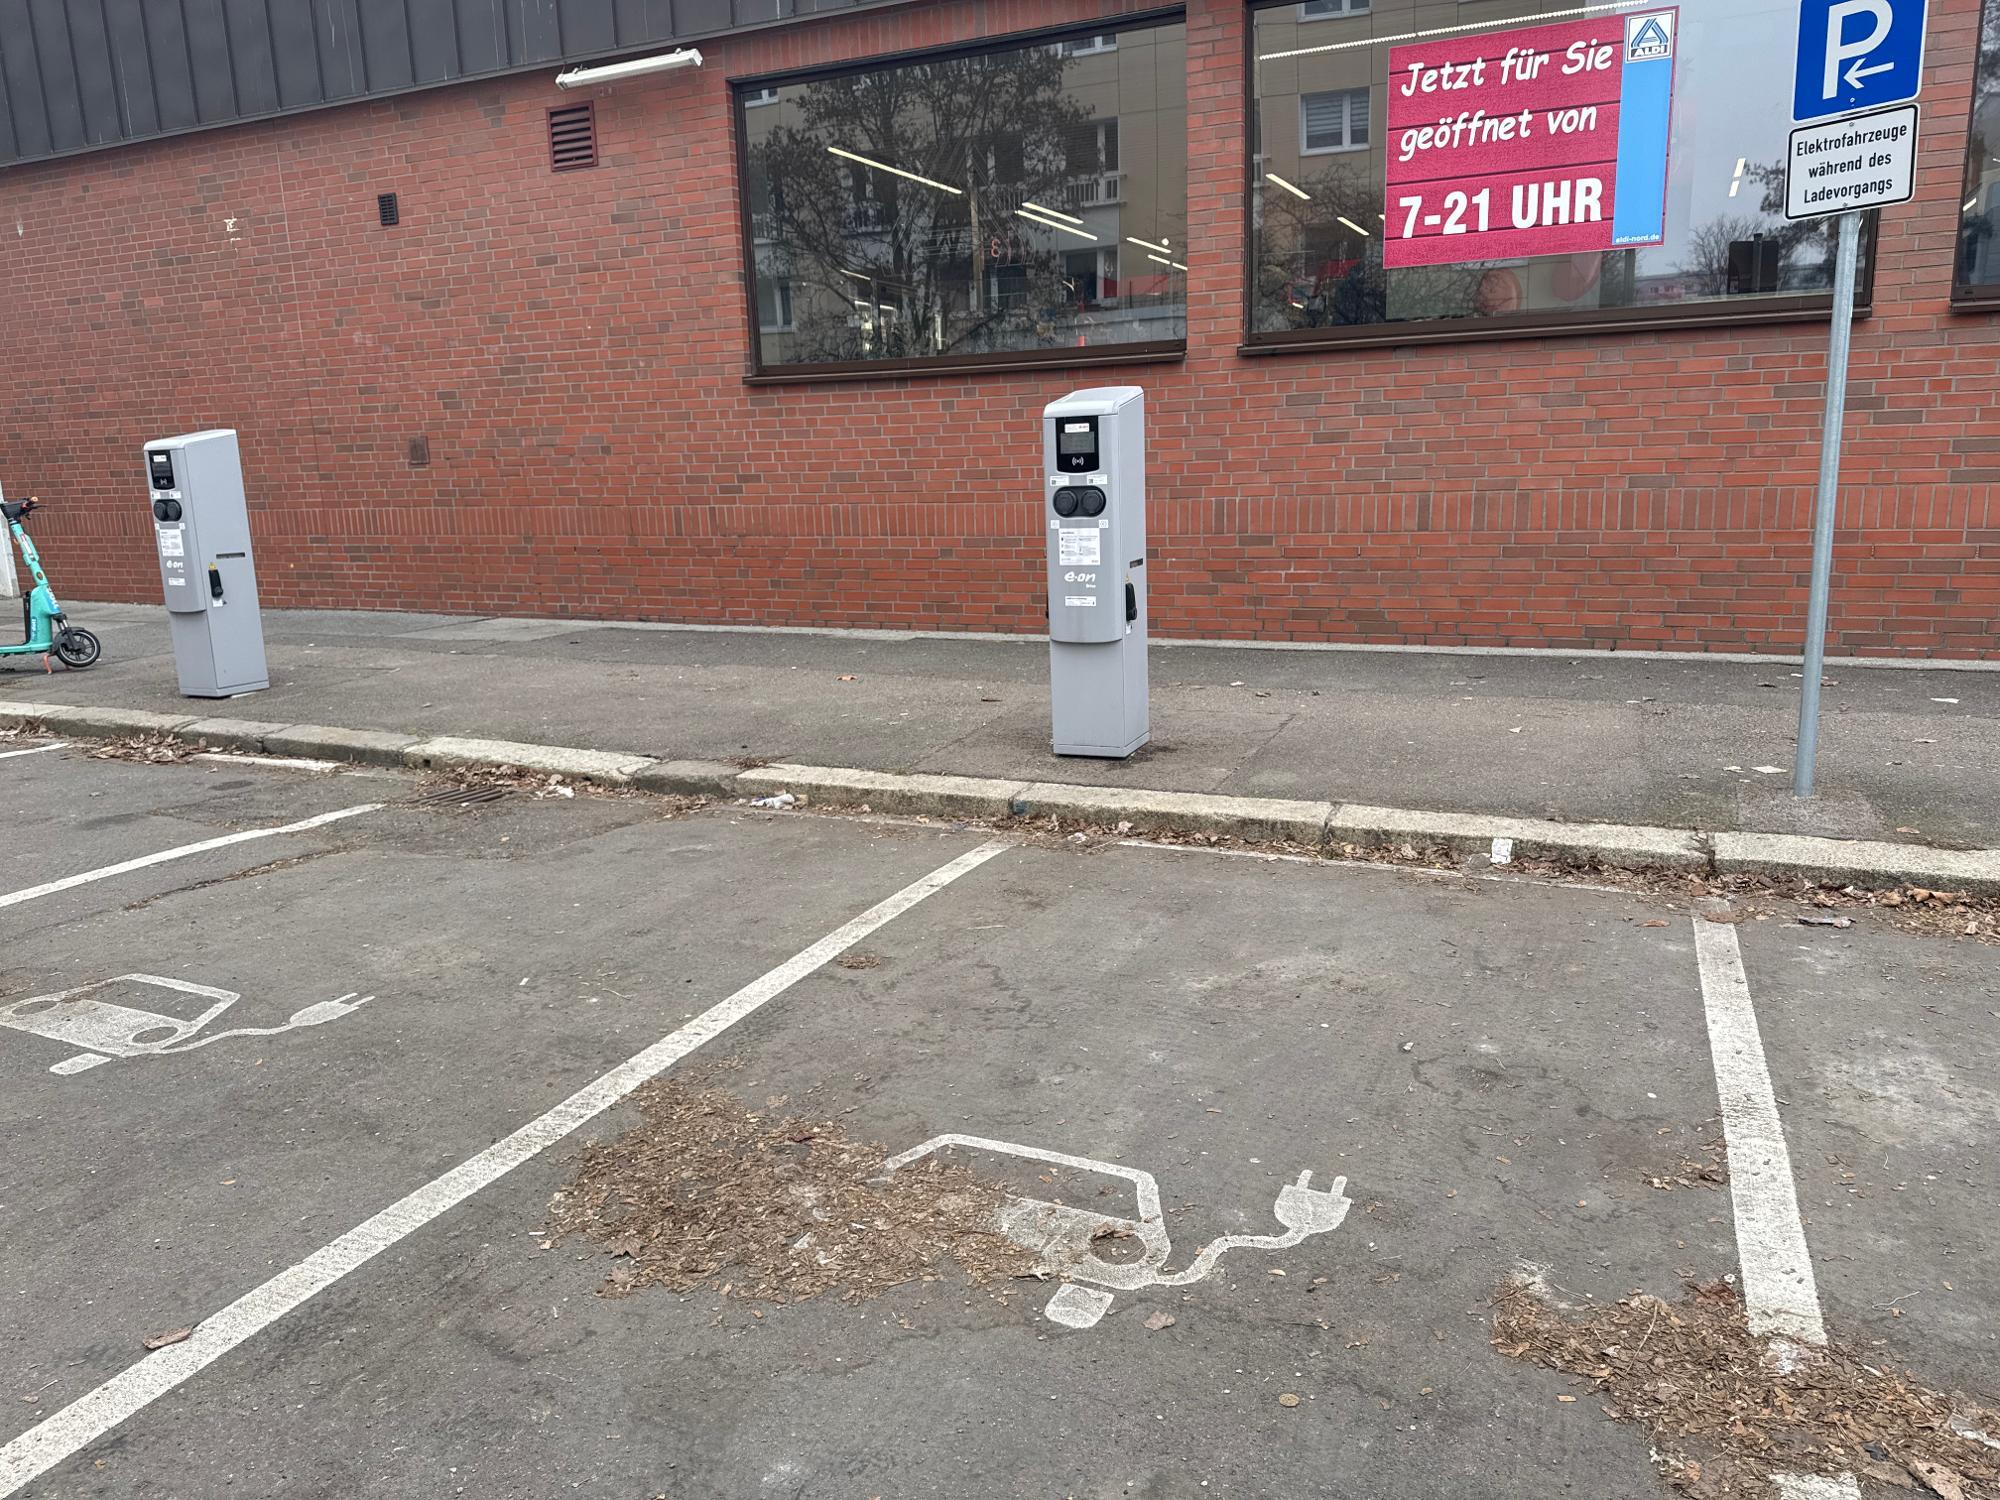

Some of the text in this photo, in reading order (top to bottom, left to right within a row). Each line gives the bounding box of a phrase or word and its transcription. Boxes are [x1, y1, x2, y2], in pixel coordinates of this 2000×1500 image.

[1633, 44, 1667, 57] ALDI
[1822, 0, 1893, 100] P
[1401, 38, 1614, 97] Jetzt für Sie
[1398, 105, 1598, 162] geöffnet von
[1796, 124, 1908, 156] Elektrofahrzeuge
[1808, 152, 1892, 178] während des
[1803, 178, 1893, 204] Ladevorgangs
[1399, 177, 1603, 239] 7-21 UHR
[1615, 233, 1660, 243] aldi-nord.de
